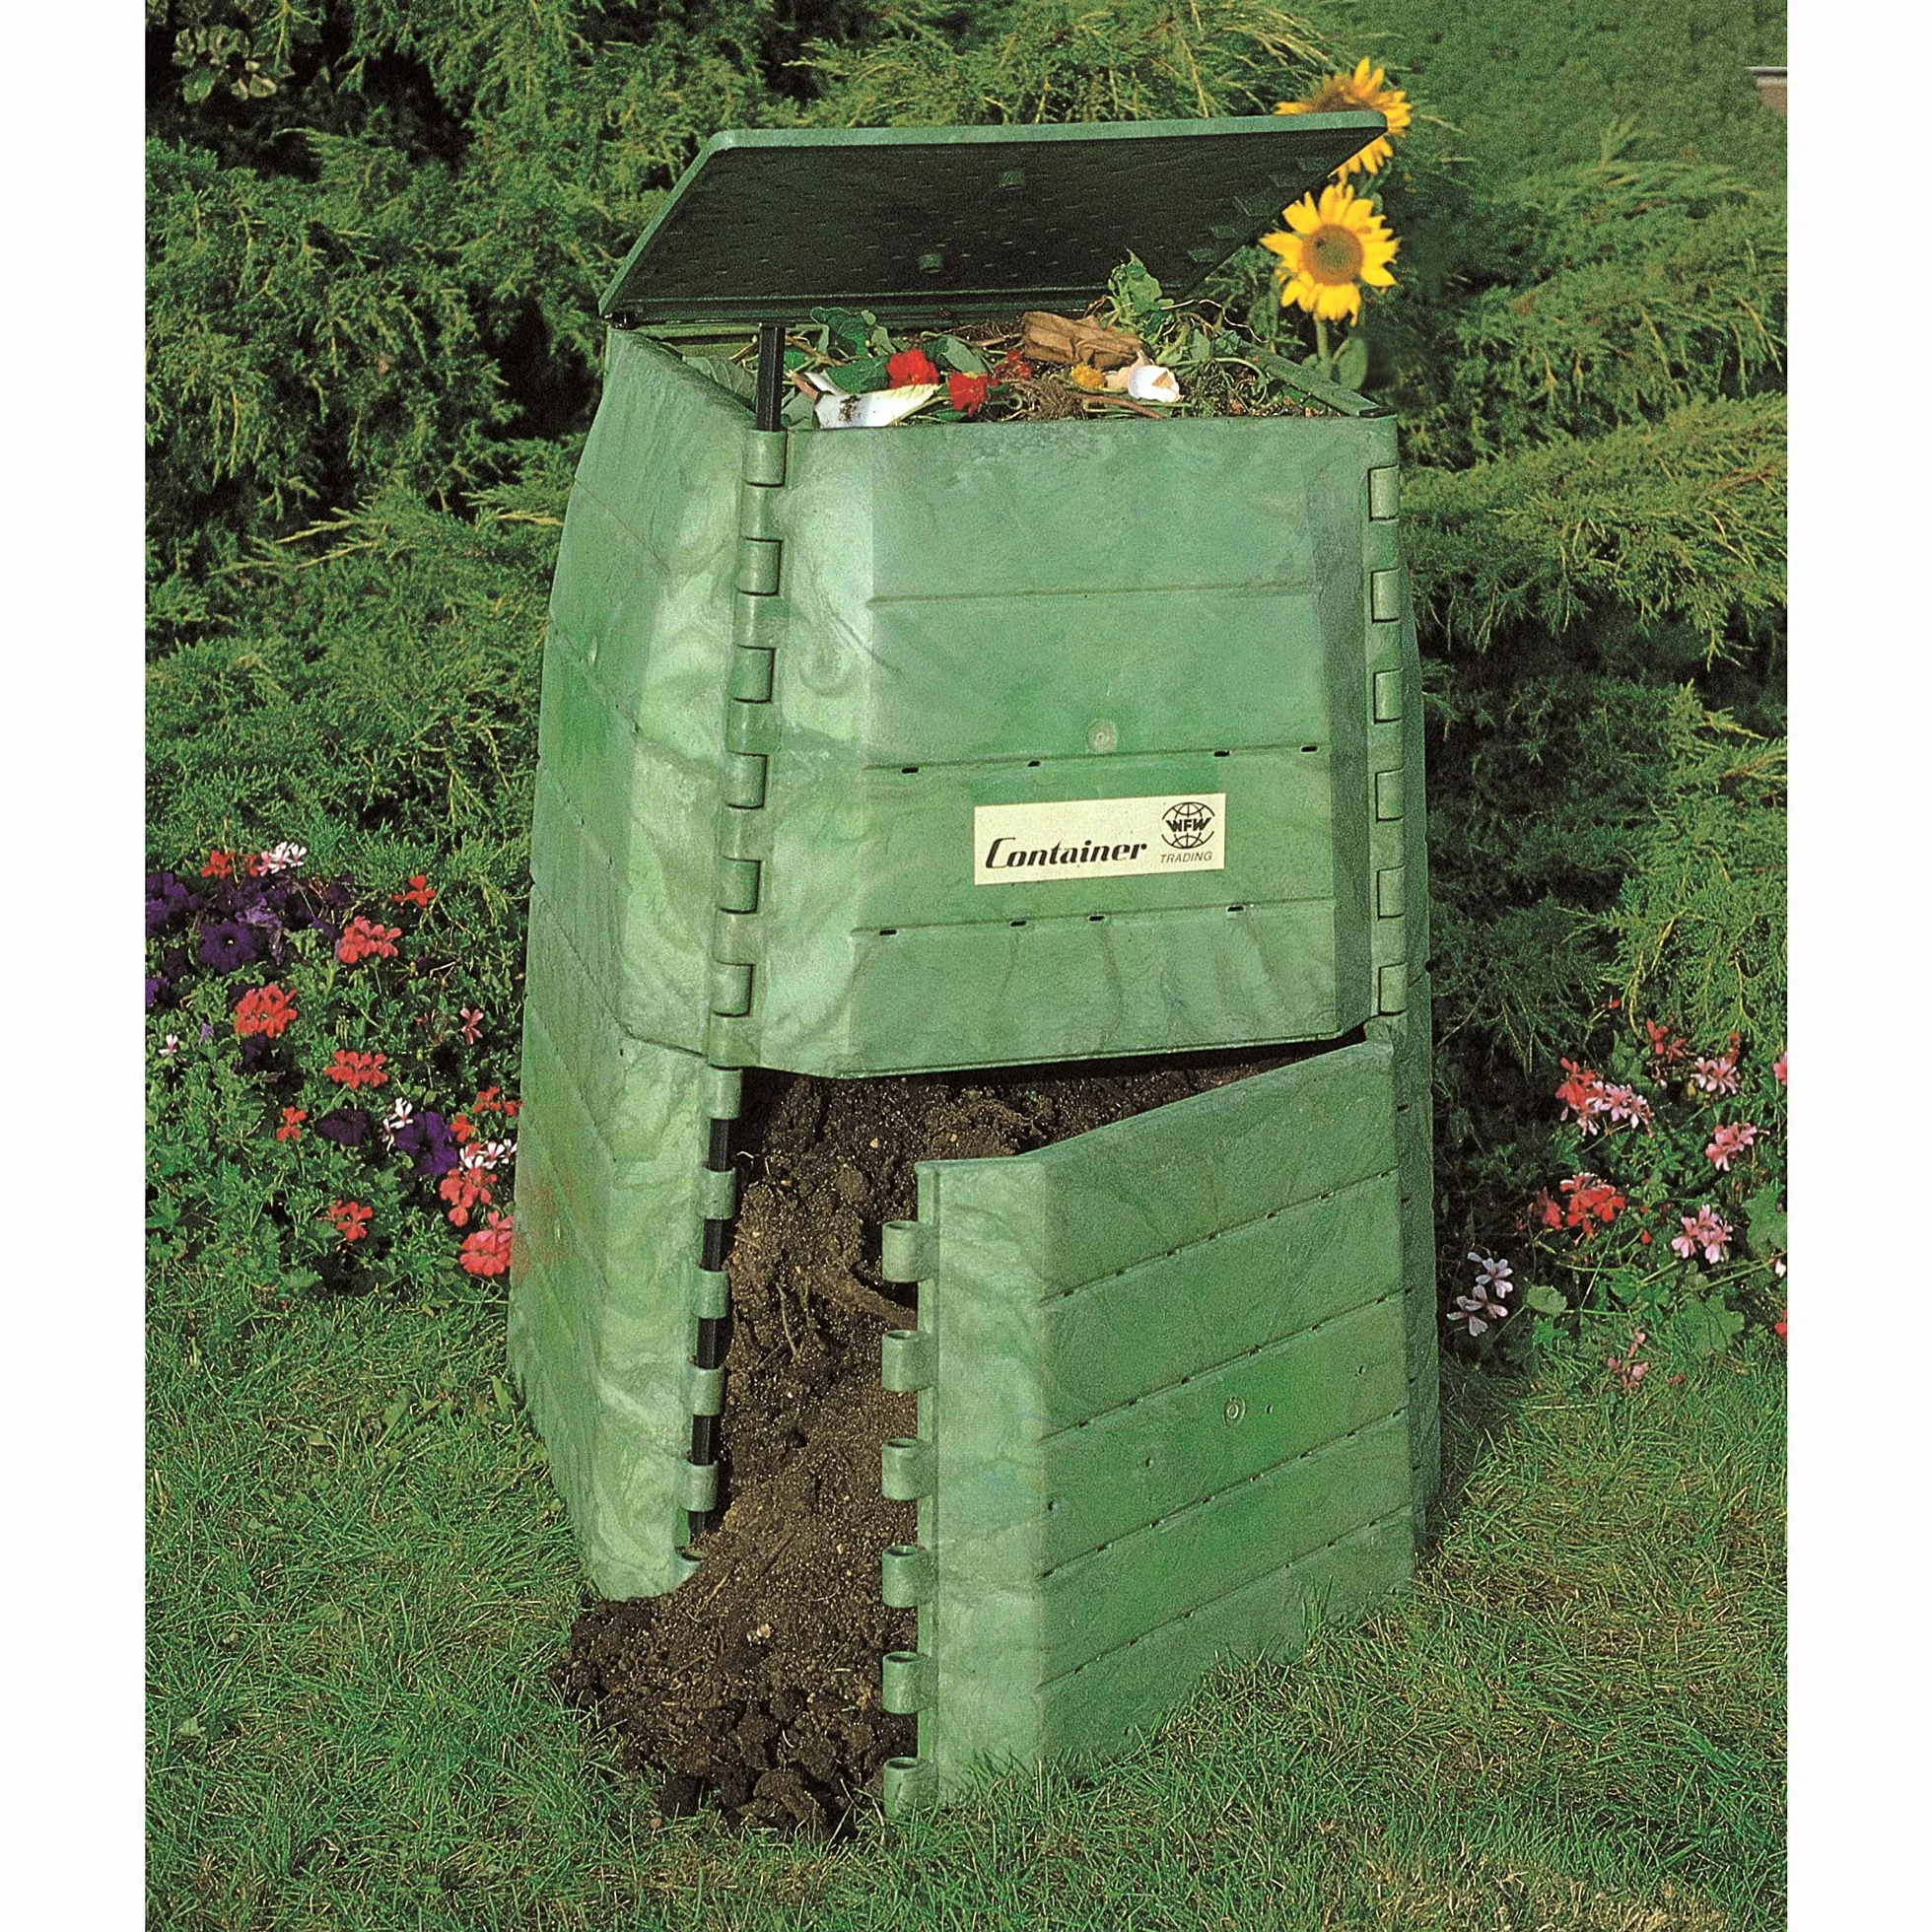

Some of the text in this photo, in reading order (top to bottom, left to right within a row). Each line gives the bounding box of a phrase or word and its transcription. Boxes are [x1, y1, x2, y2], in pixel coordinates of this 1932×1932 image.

[1165, 817, 1212, 832] WFW
[985, 837, 1147, 869] Container
[1160, 851, 1212, 864] TRADING
